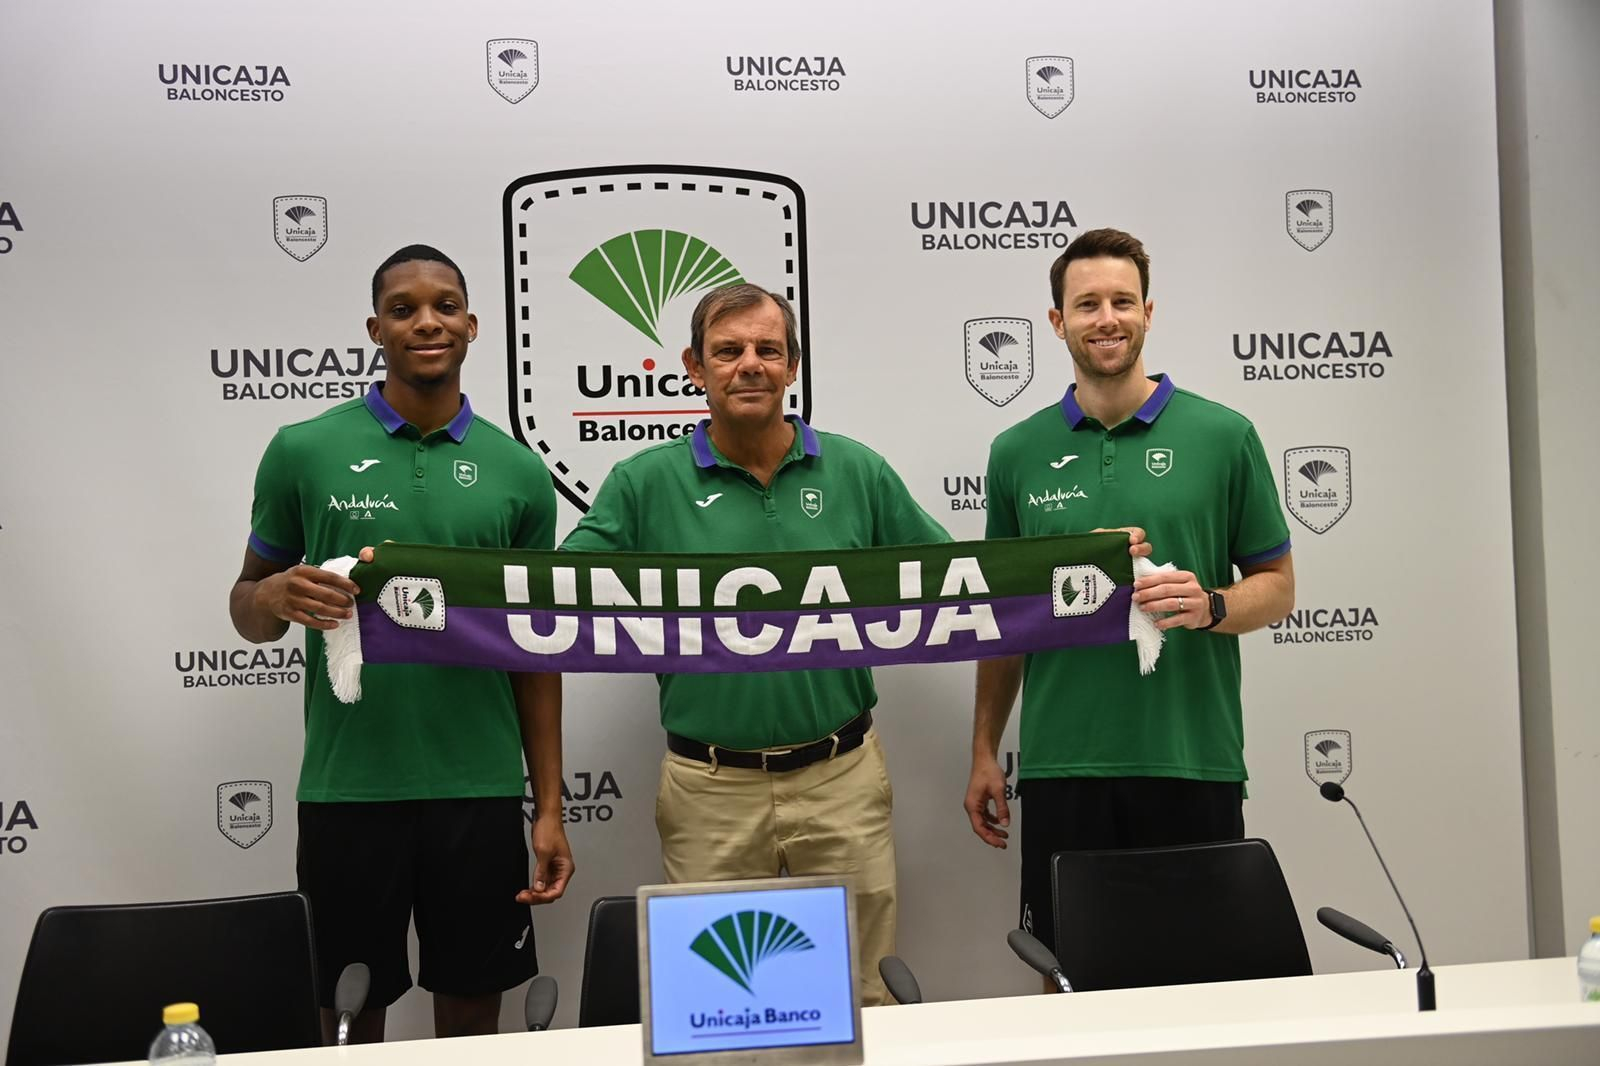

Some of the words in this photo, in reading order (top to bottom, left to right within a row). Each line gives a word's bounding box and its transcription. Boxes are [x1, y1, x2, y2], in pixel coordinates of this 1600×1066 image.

[158, 63, 291, 87] UNICAJA
[498, 70, 528, 79] Unicaja
[727, 56, 847, 76] UNICAJA
[734, 79, 840, 91] BALONCESTO
[1249, 69, 1362, 89] UNICAJA
[167, 87, 285, 102] BALONCESTO
[1037, 86, 1064, 95] Unicaja
[1256, 91, 1357, 103] BALONCESTO
[911, 201, 1078, 229] UNICAJA
[286, 227, 316, 237] Unicaja
[921, 233, 1069, 250] BALONCESTO
[1232, 331, 1394, 360] UNICAJA
[210, 348, 387, 378] UNICAJA
[980, 360, 1018, 372] Unicaja
[1243, 362, 1385, 380] BALONCESTO
[222, 381, 370, 400] BALONCEST
[577, 358, 710, 406] Unica
[579, 419, 697, 442] Balonce
[1300, 488, 1337, 500] Unicaja
[503, 557, 1002, 656] UNICAJA
[1268, 607, 1379, 630] NICAJA
[1273, 629, 1373, 644] BALONCESTO
[175, 647, 306, 673] UNICAJA
[183, 671, 300, 688] BALONCESTO
[229, 812, 261, 822] Unicaja
[690, 1007, 761, 1030] Unicaja
[764, 1007, 822, 1024] Banco
